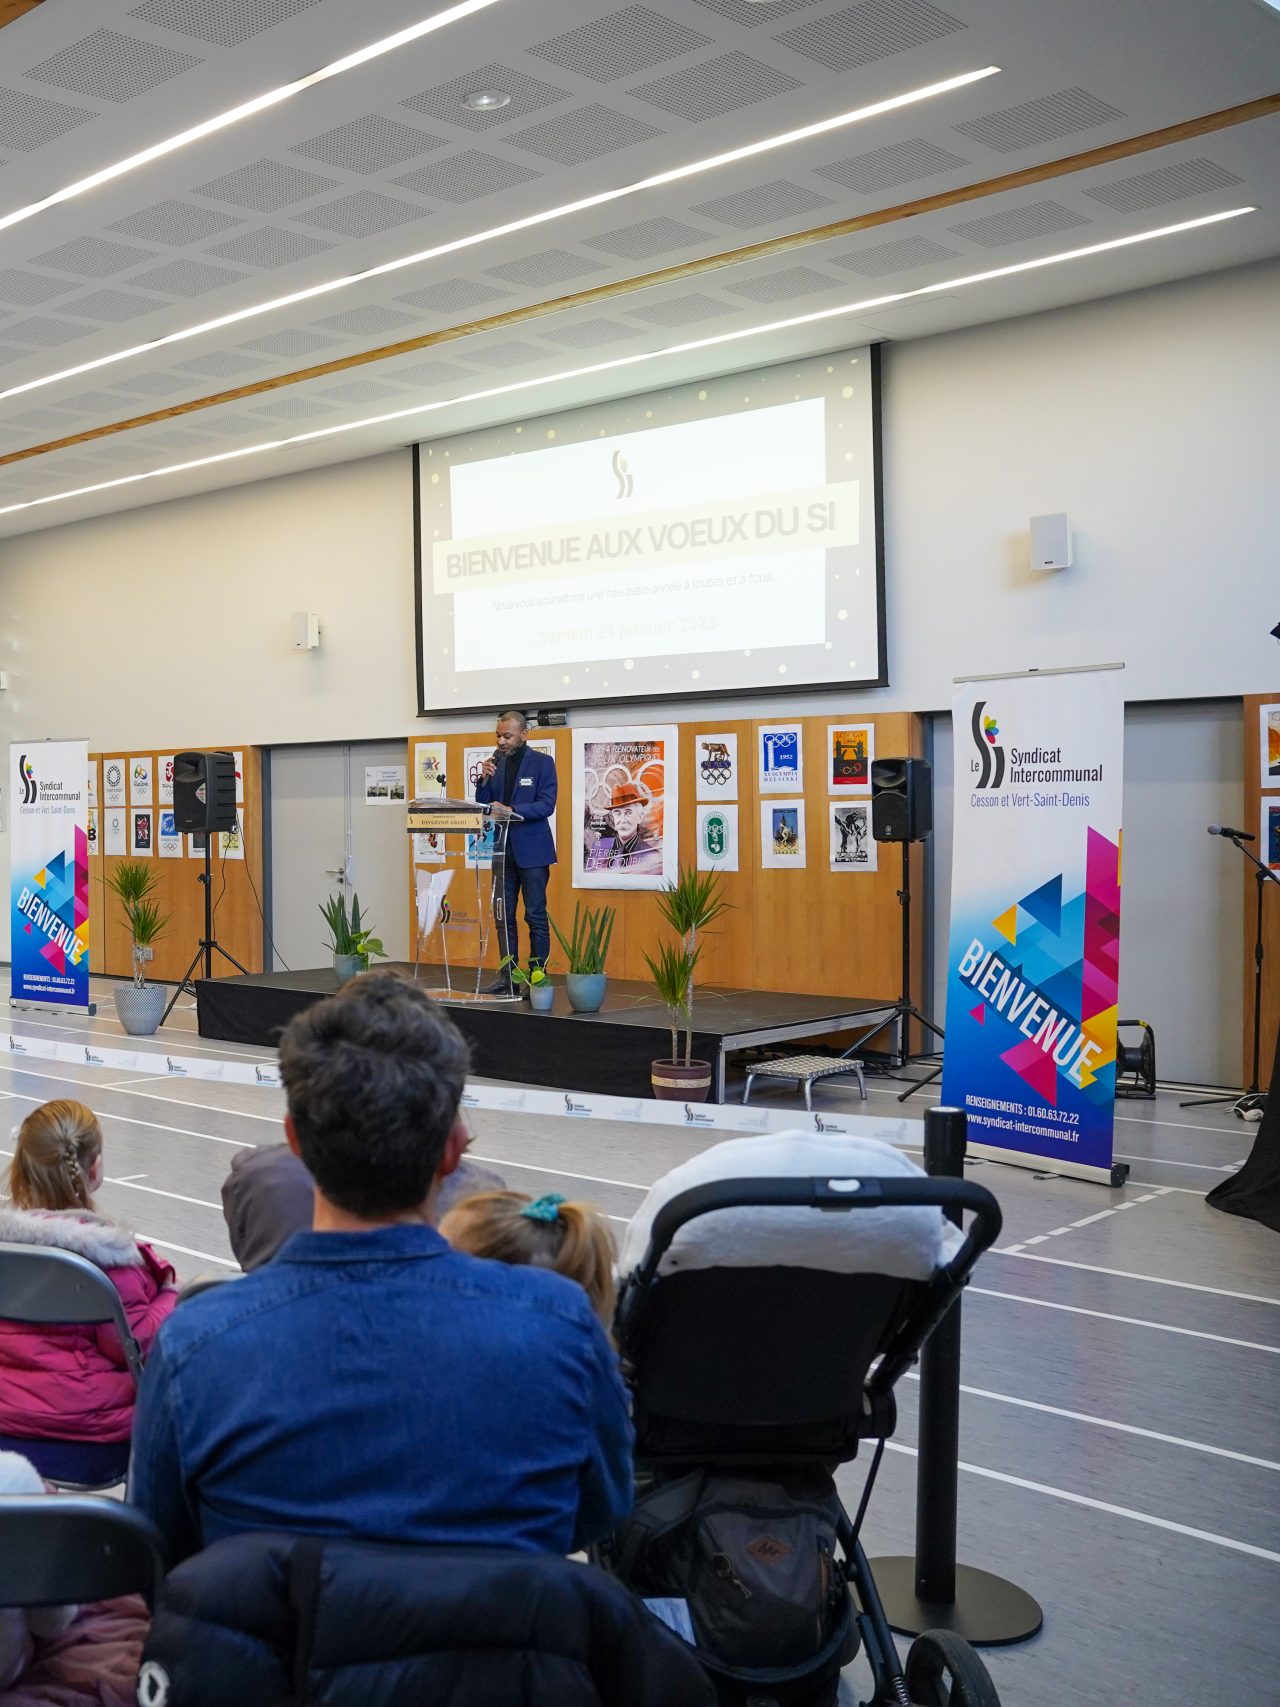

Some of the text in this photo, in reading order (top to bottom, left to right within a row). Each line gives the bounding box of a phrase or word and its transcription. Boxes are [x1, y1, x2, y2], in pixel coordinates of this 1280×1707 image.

[446, 500, 836, 579] BIENVENUE AUX VOEUX DU SI
[491, 600, 514, 611] Nous
[515, 599, 535, 609] vous
[536, 591, 585, 607] souhaitons
[586, 591, 604, 601] une
[692, 578, 724, 590] toutes
[726, 576, 738, 586] et
[539, 625, 593, 645] Samedi
[596, 624, 613, 640] 24
[616, 618, 675, 643] janvier
[618, 752, 661, 764] OLYMPIQUES
[970, 747, 1062, 773] Le Syndicat
[40, 780, 63, 792] Syndicat
[1010, 764, 1103, 784] Intercommunal
[40, 791, 81, 801] Intercommunal
[971, 792, 1090, 808] Cesson et Vert-Saint-Denis
[586, 857, 608, 870] DE
[589, 848, 620, 857] PIERRE
[17, 887, 84, 964] BIENVENUE
[958, 938, 1102, 1083] BIENVENUE
[966, 1095, 1022, 1115] RENSEIGNEMENTS
[1028, 1106, 1079, 1124] 01.60.63.72.22
[966, 1114, 1079, 1142] www.syndicat-intercommunal.fr
